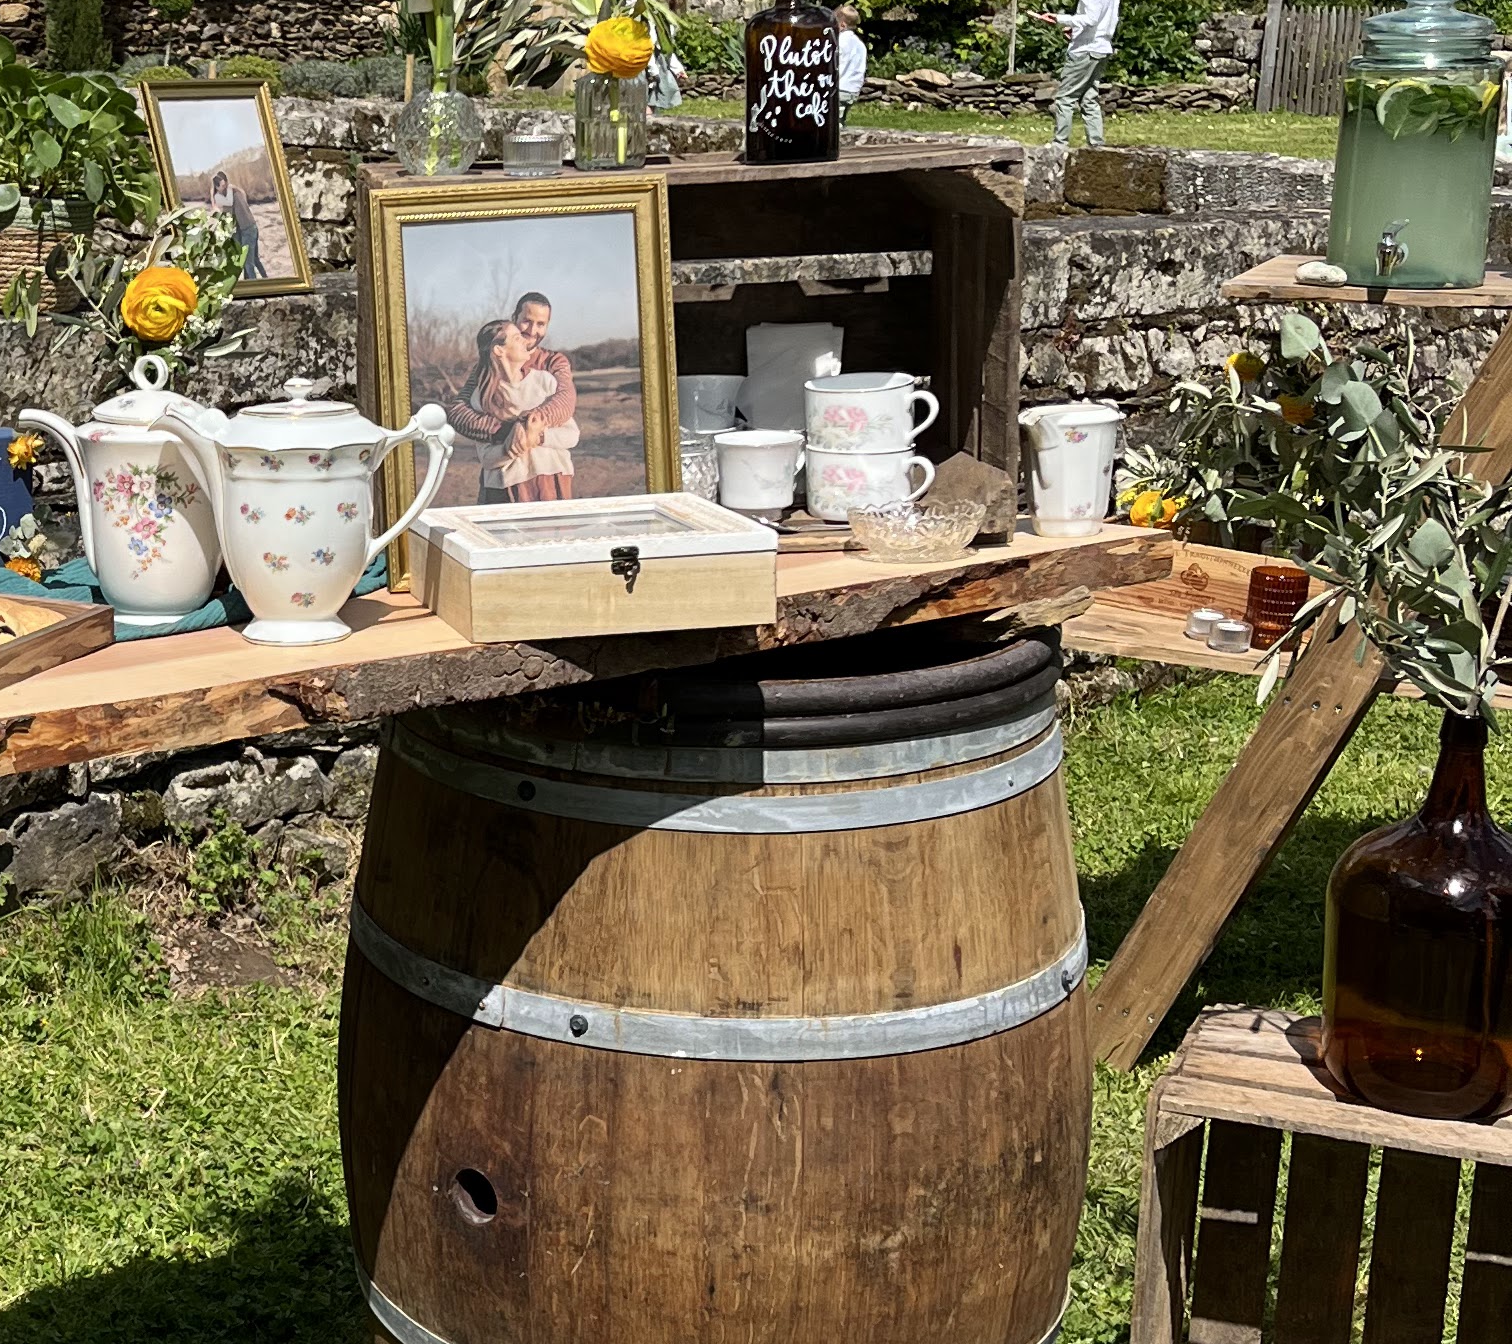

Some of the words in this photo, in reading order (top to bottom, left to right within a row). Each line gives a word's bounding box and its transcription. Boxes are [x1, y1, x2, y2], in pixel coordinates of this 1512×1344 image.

[759, 34, 833, 73] Plutôt
[767, 69, 815, 102] thé
[795, 91, 830, 128] café
